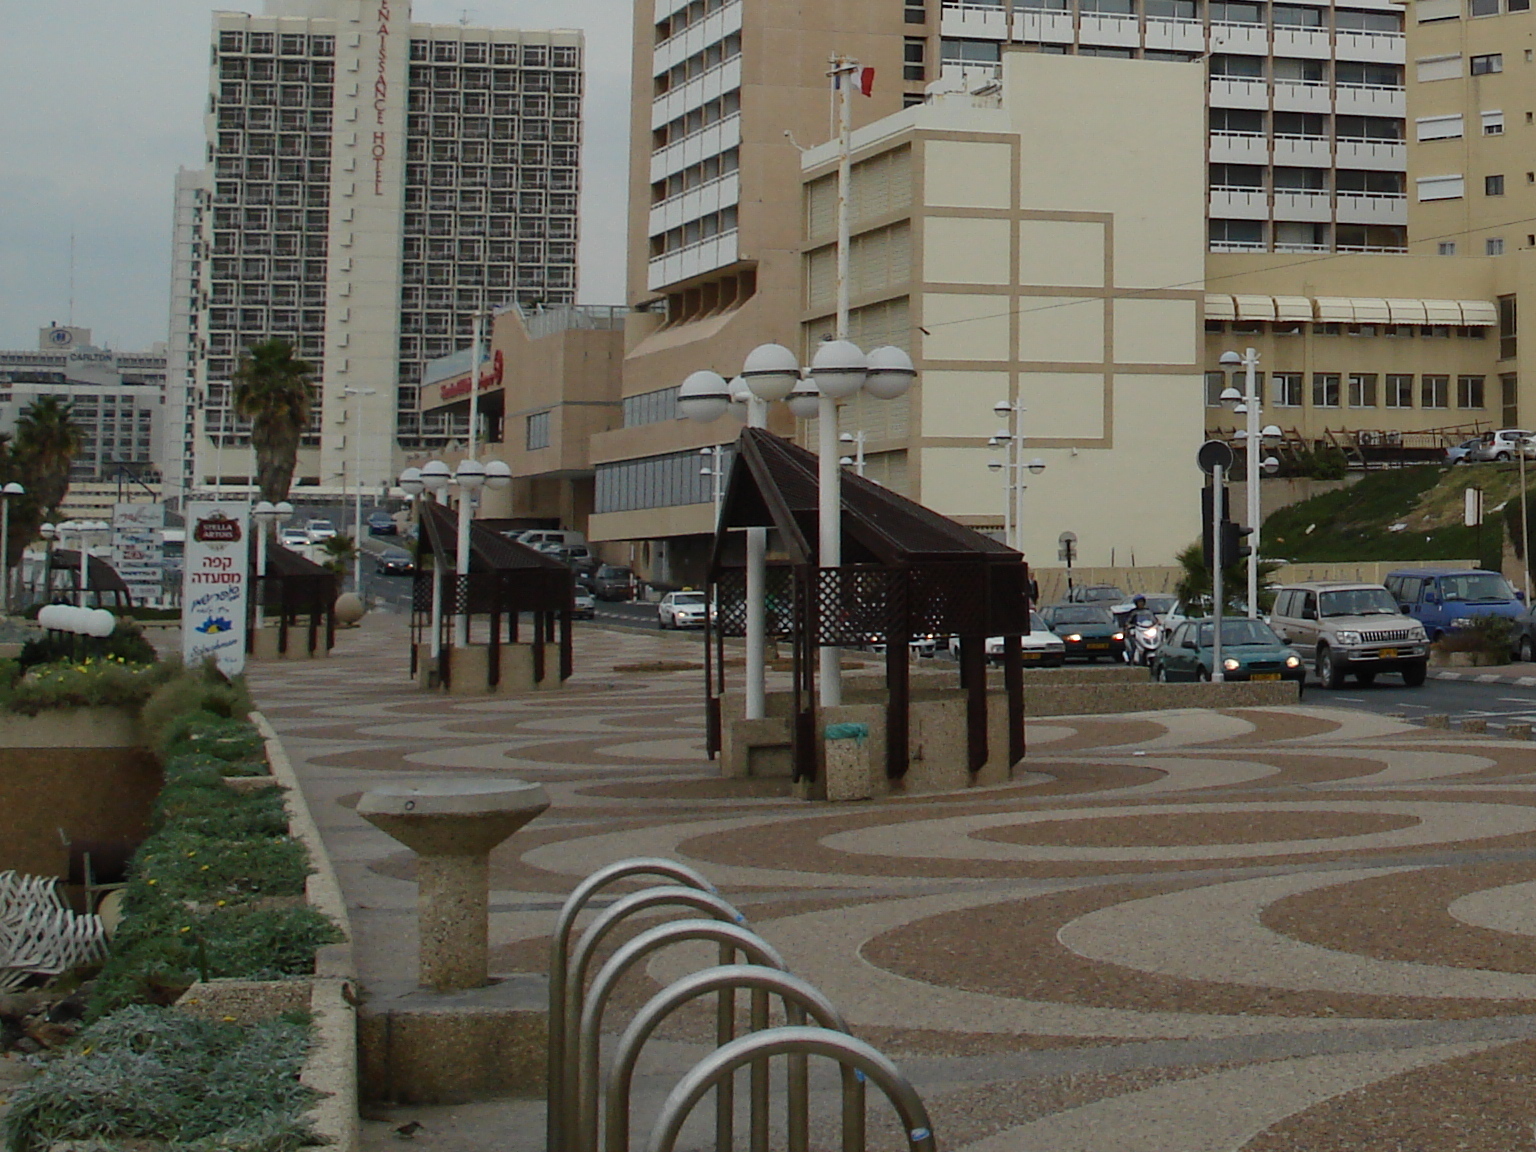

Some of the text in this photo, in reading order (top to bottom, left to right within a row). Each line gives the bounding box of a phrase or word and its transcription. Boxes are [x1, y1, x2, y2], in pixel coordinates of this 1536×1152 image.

[371, 131, 386, 196] HOTEL
[70, 353, 113, 362] CARLTON
[202, 557, 232, 571] קפה
[191, 573, 241, 584] מסעדה
